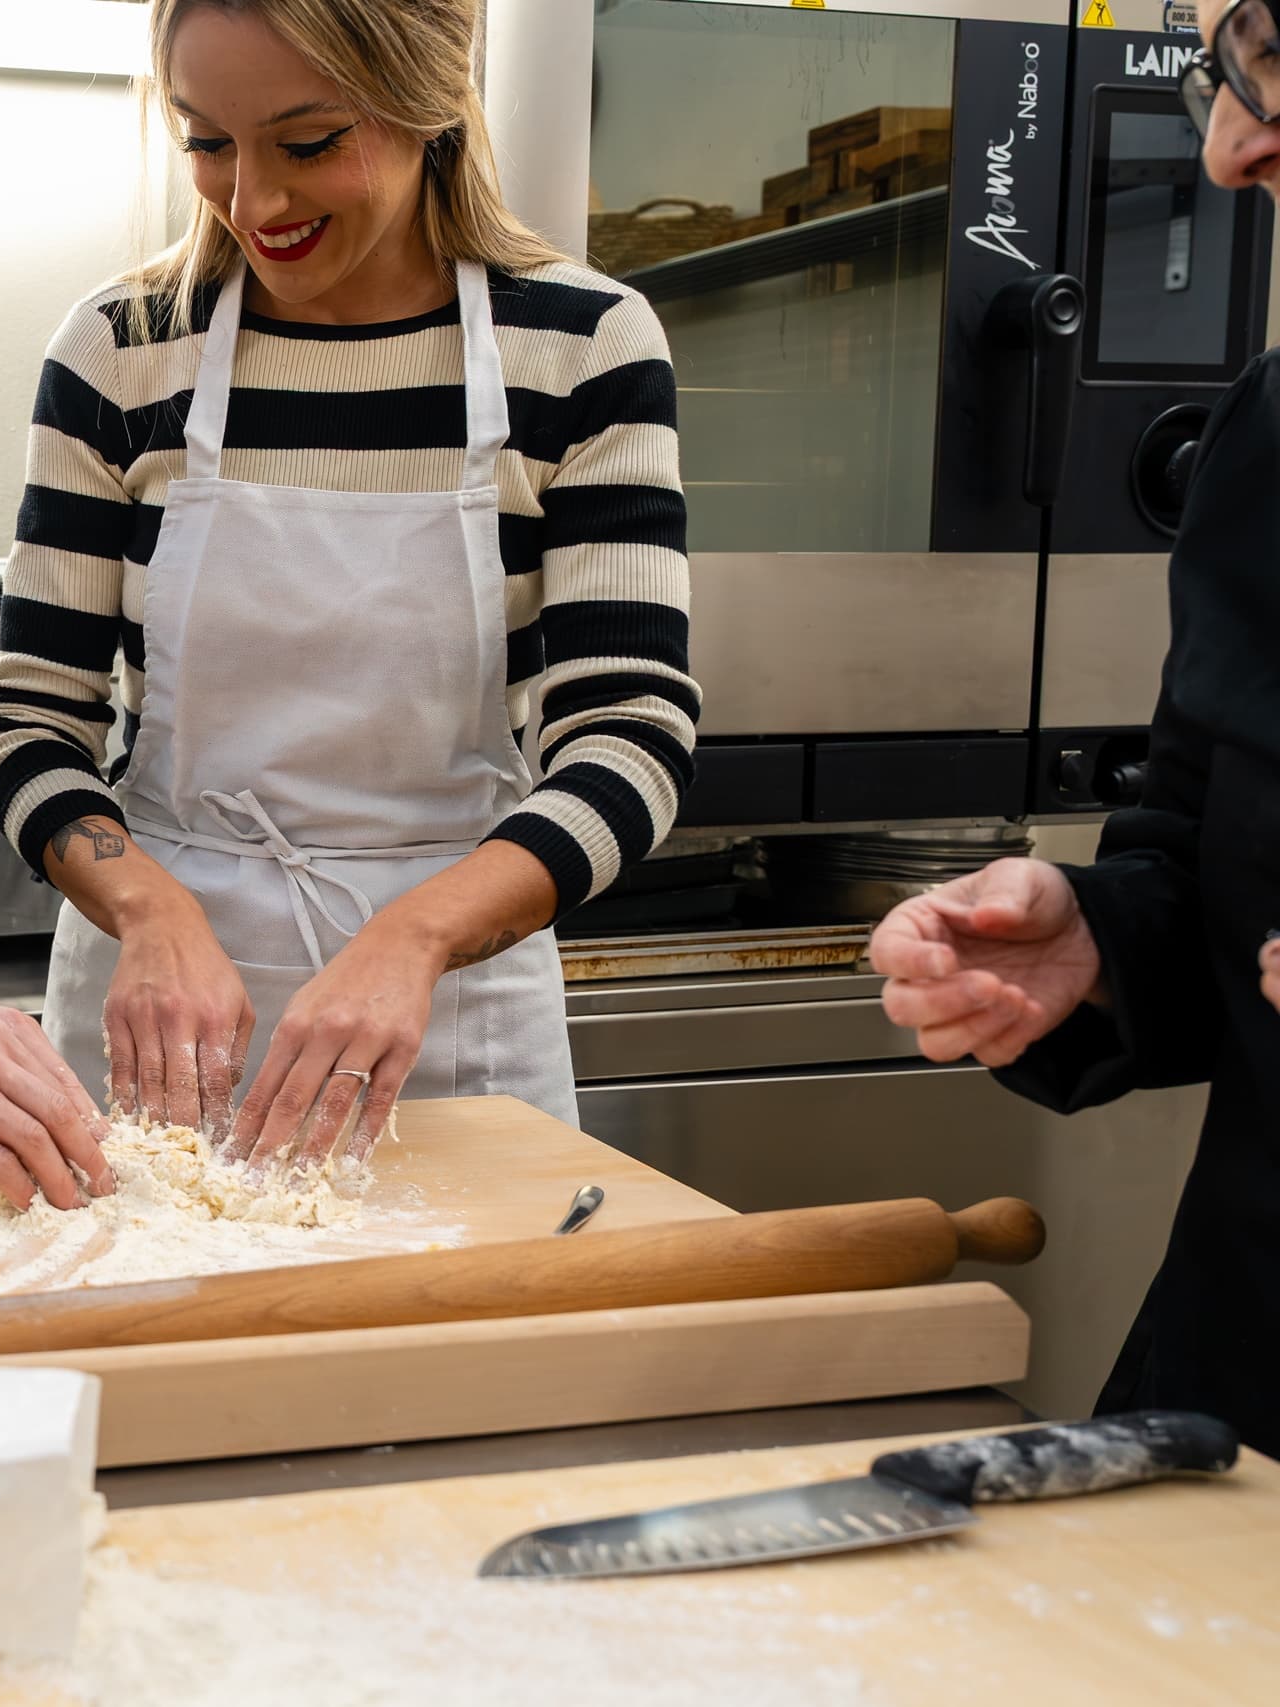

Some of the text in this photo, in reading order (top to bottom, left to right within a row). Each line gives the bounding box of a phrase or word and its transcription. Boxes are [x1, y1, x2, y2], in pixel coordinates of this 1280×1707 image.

[1017, 42, 1040, 139] by Naboo
[965, 128, 1041, 270] Aroma
